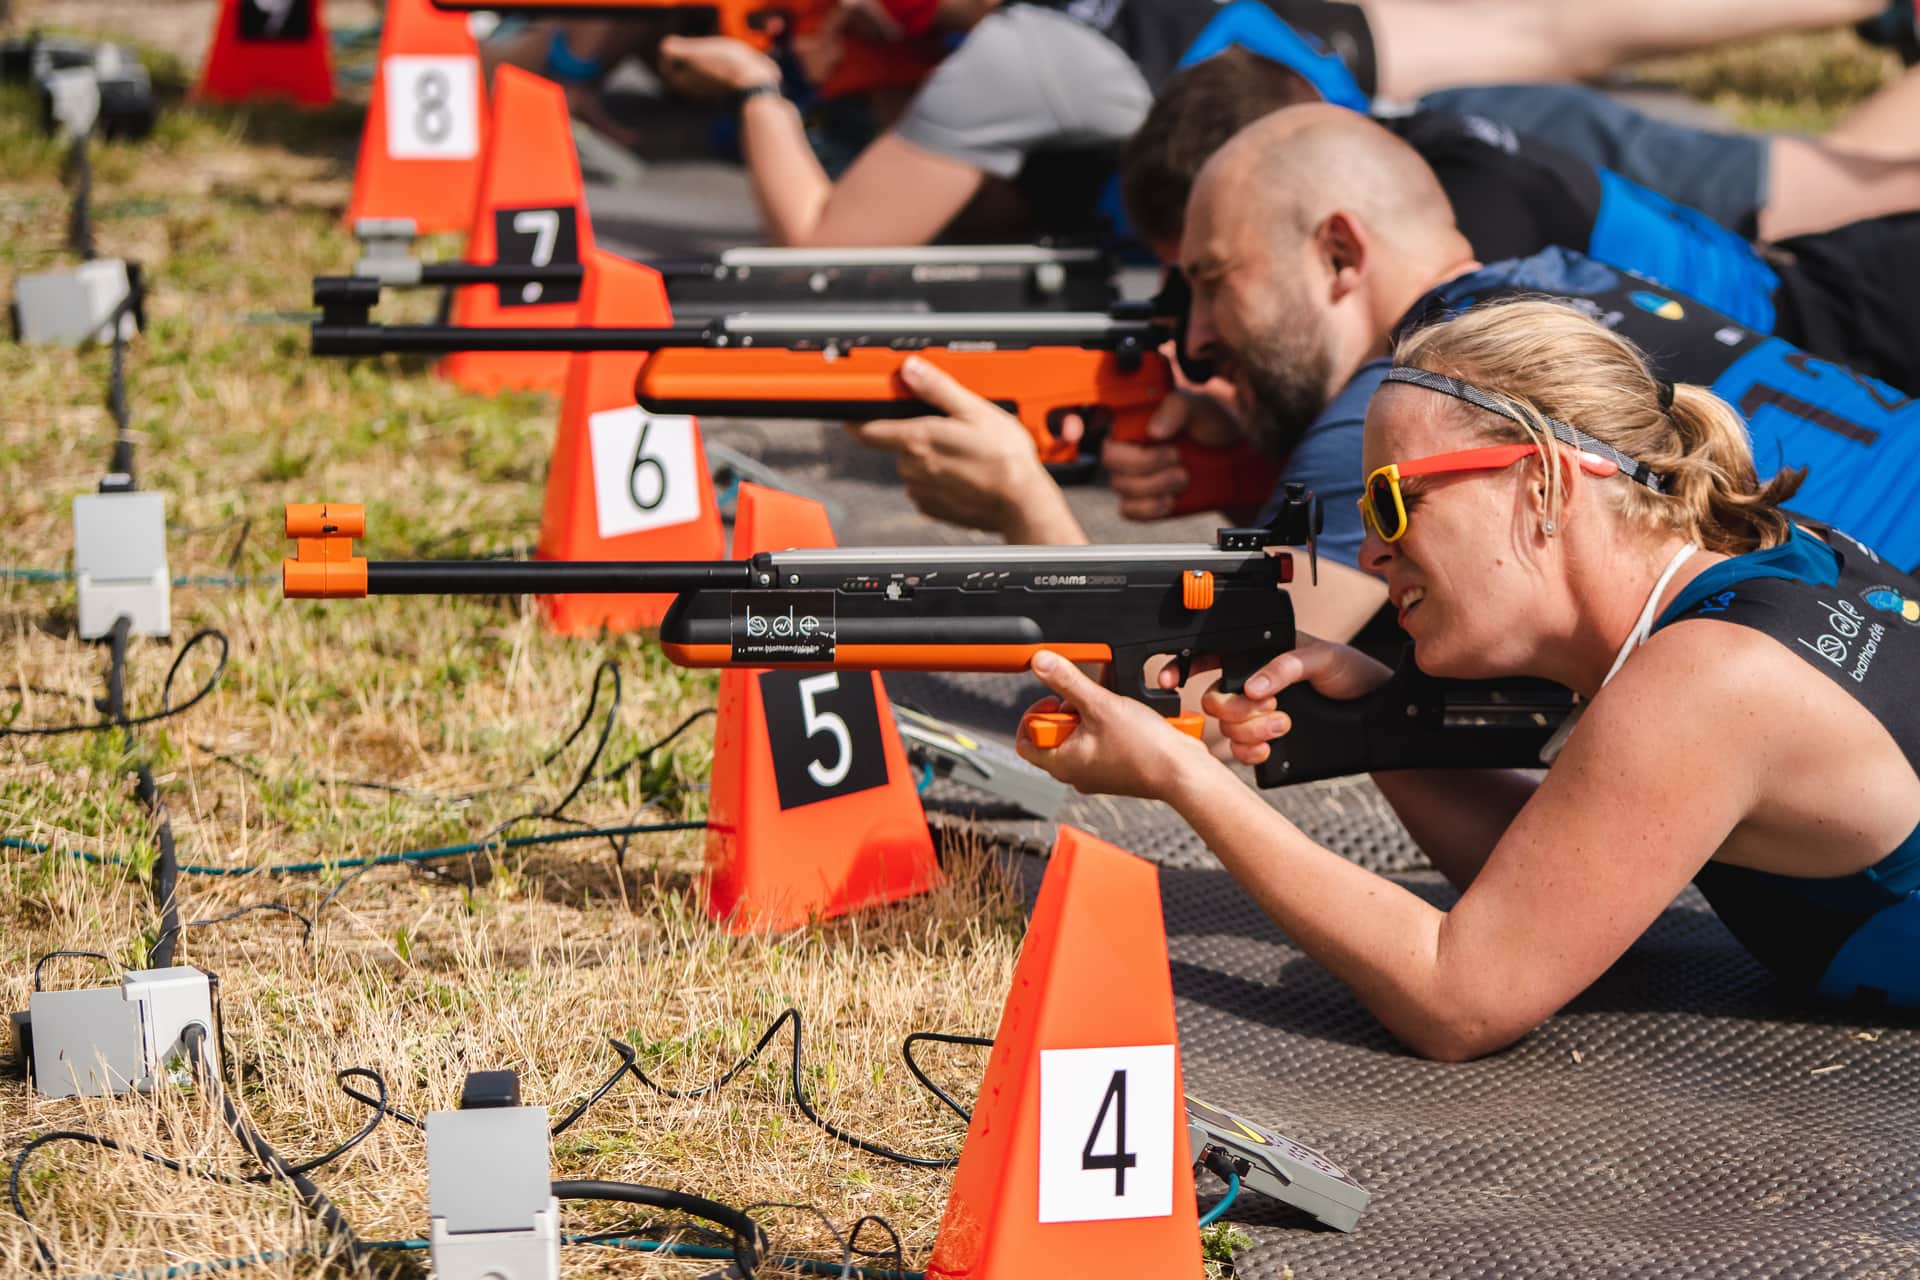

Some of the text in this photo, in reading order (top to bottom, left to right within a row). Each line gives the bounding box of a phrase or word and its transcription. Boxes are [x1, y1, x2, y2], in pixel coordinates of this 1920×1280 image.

[415, 70, 452, 147] 8
[514, 210, 560, 303] 7
[628, 421, 667, 512] 6
[799, 671, 852, 787] 5
[1082, 1069, 1137, 1196] 4
